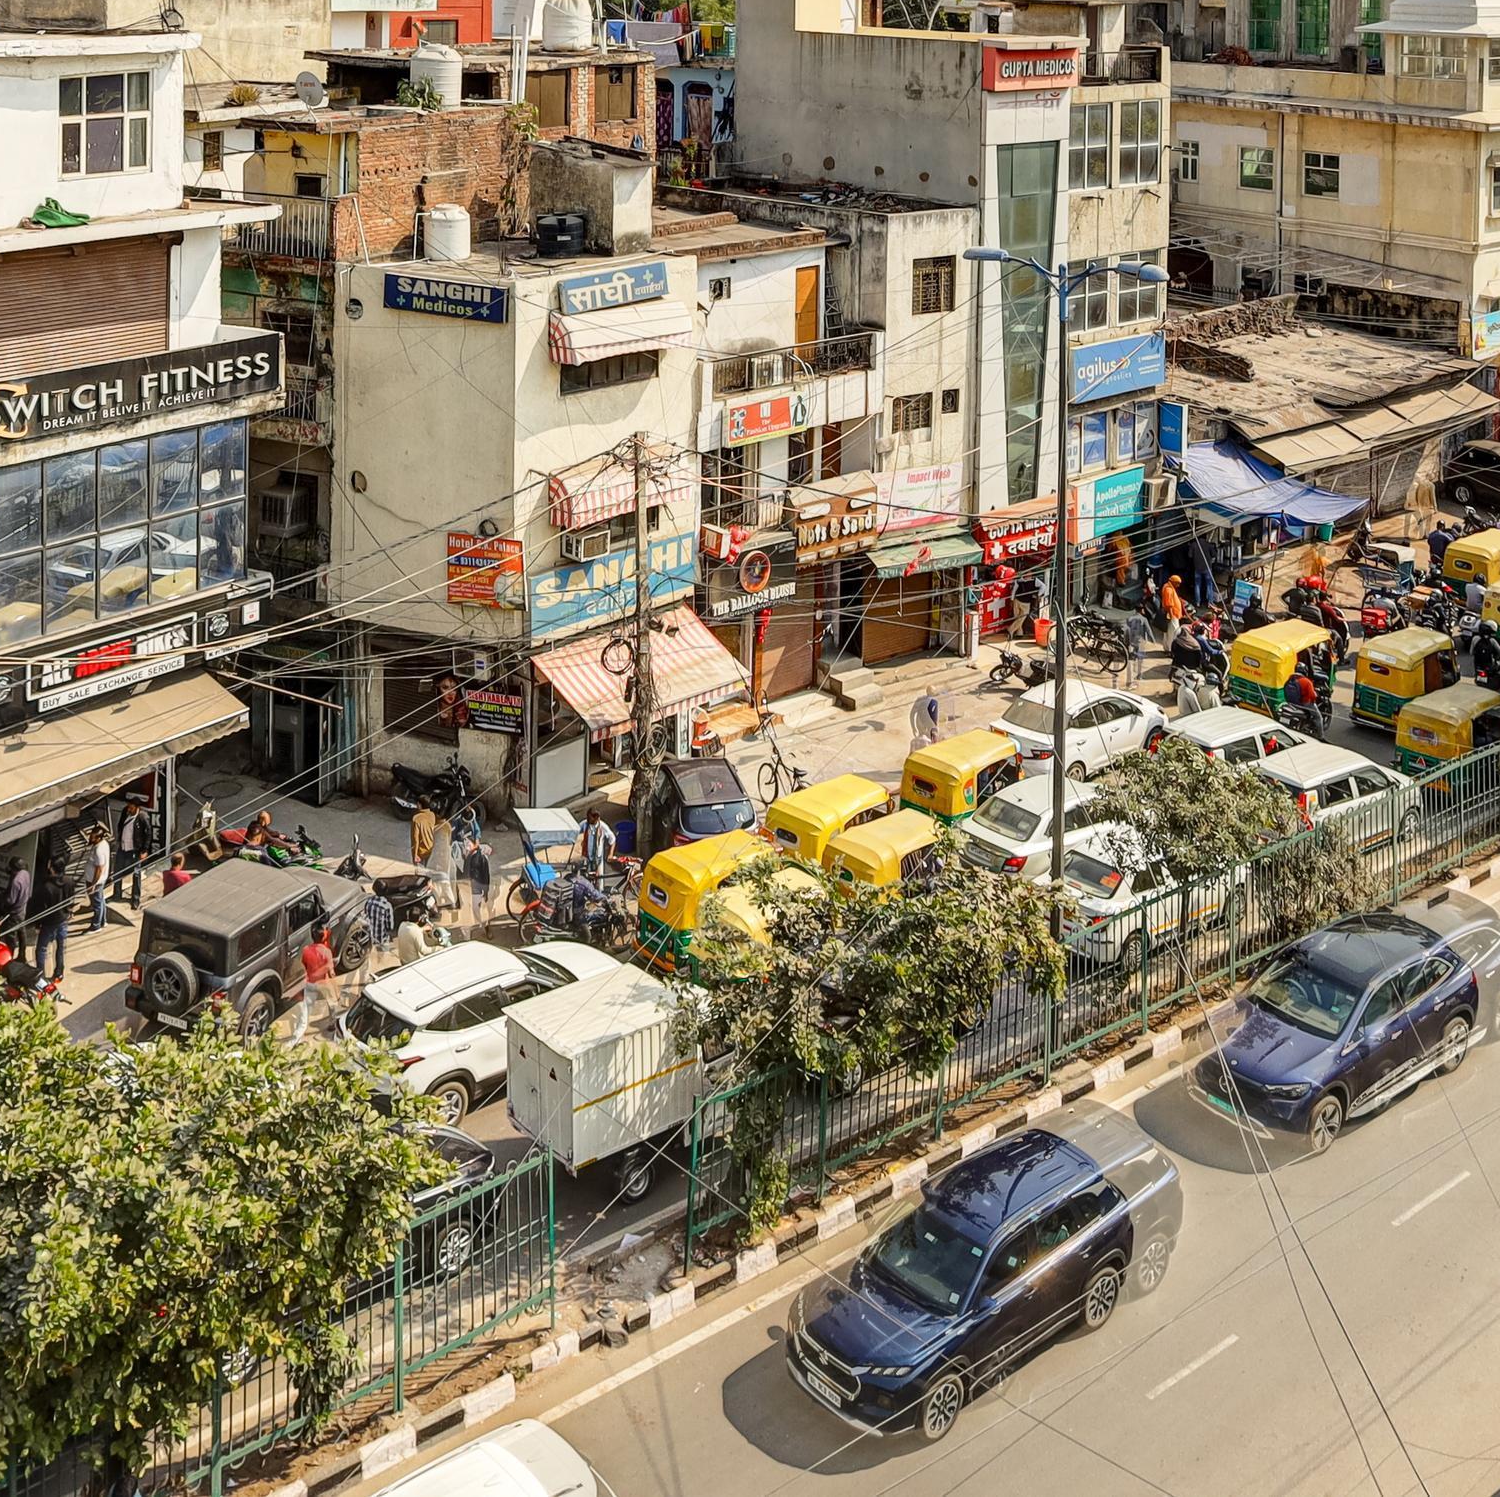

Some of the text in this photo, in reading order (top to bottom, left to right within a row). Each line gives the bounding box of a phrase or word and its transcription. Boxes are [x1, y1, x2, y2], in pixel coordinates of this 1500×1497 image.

[1001, 58, 1076, 78] GUPTA MEDICOS
[396, 276, 492, 304] SANGHI
[567, 272, 634, 314] सांघी
[412, 297, 473, 317] Medicos
[140, 352, 271, 399] FITNESS
[1077, 357, 1117, 384] agilus
[43, 387, 216, 431] DREAM IT BELIVE IT ACHIEVE IT
[906, 470, 931, 484] Impact
[449, 536, 474, 550] Hotel
[799, 523, 828, 546] Nuts
[988, 522, 1024, 540] GUPTA
[712, 599, 730, 617] THE
[730, 588, 770, 612] BALLOON
[769, 582, 797, 601] BLUSH
[42, 658, 183, 709] BUY SALE EXCHANGE SERVICE
